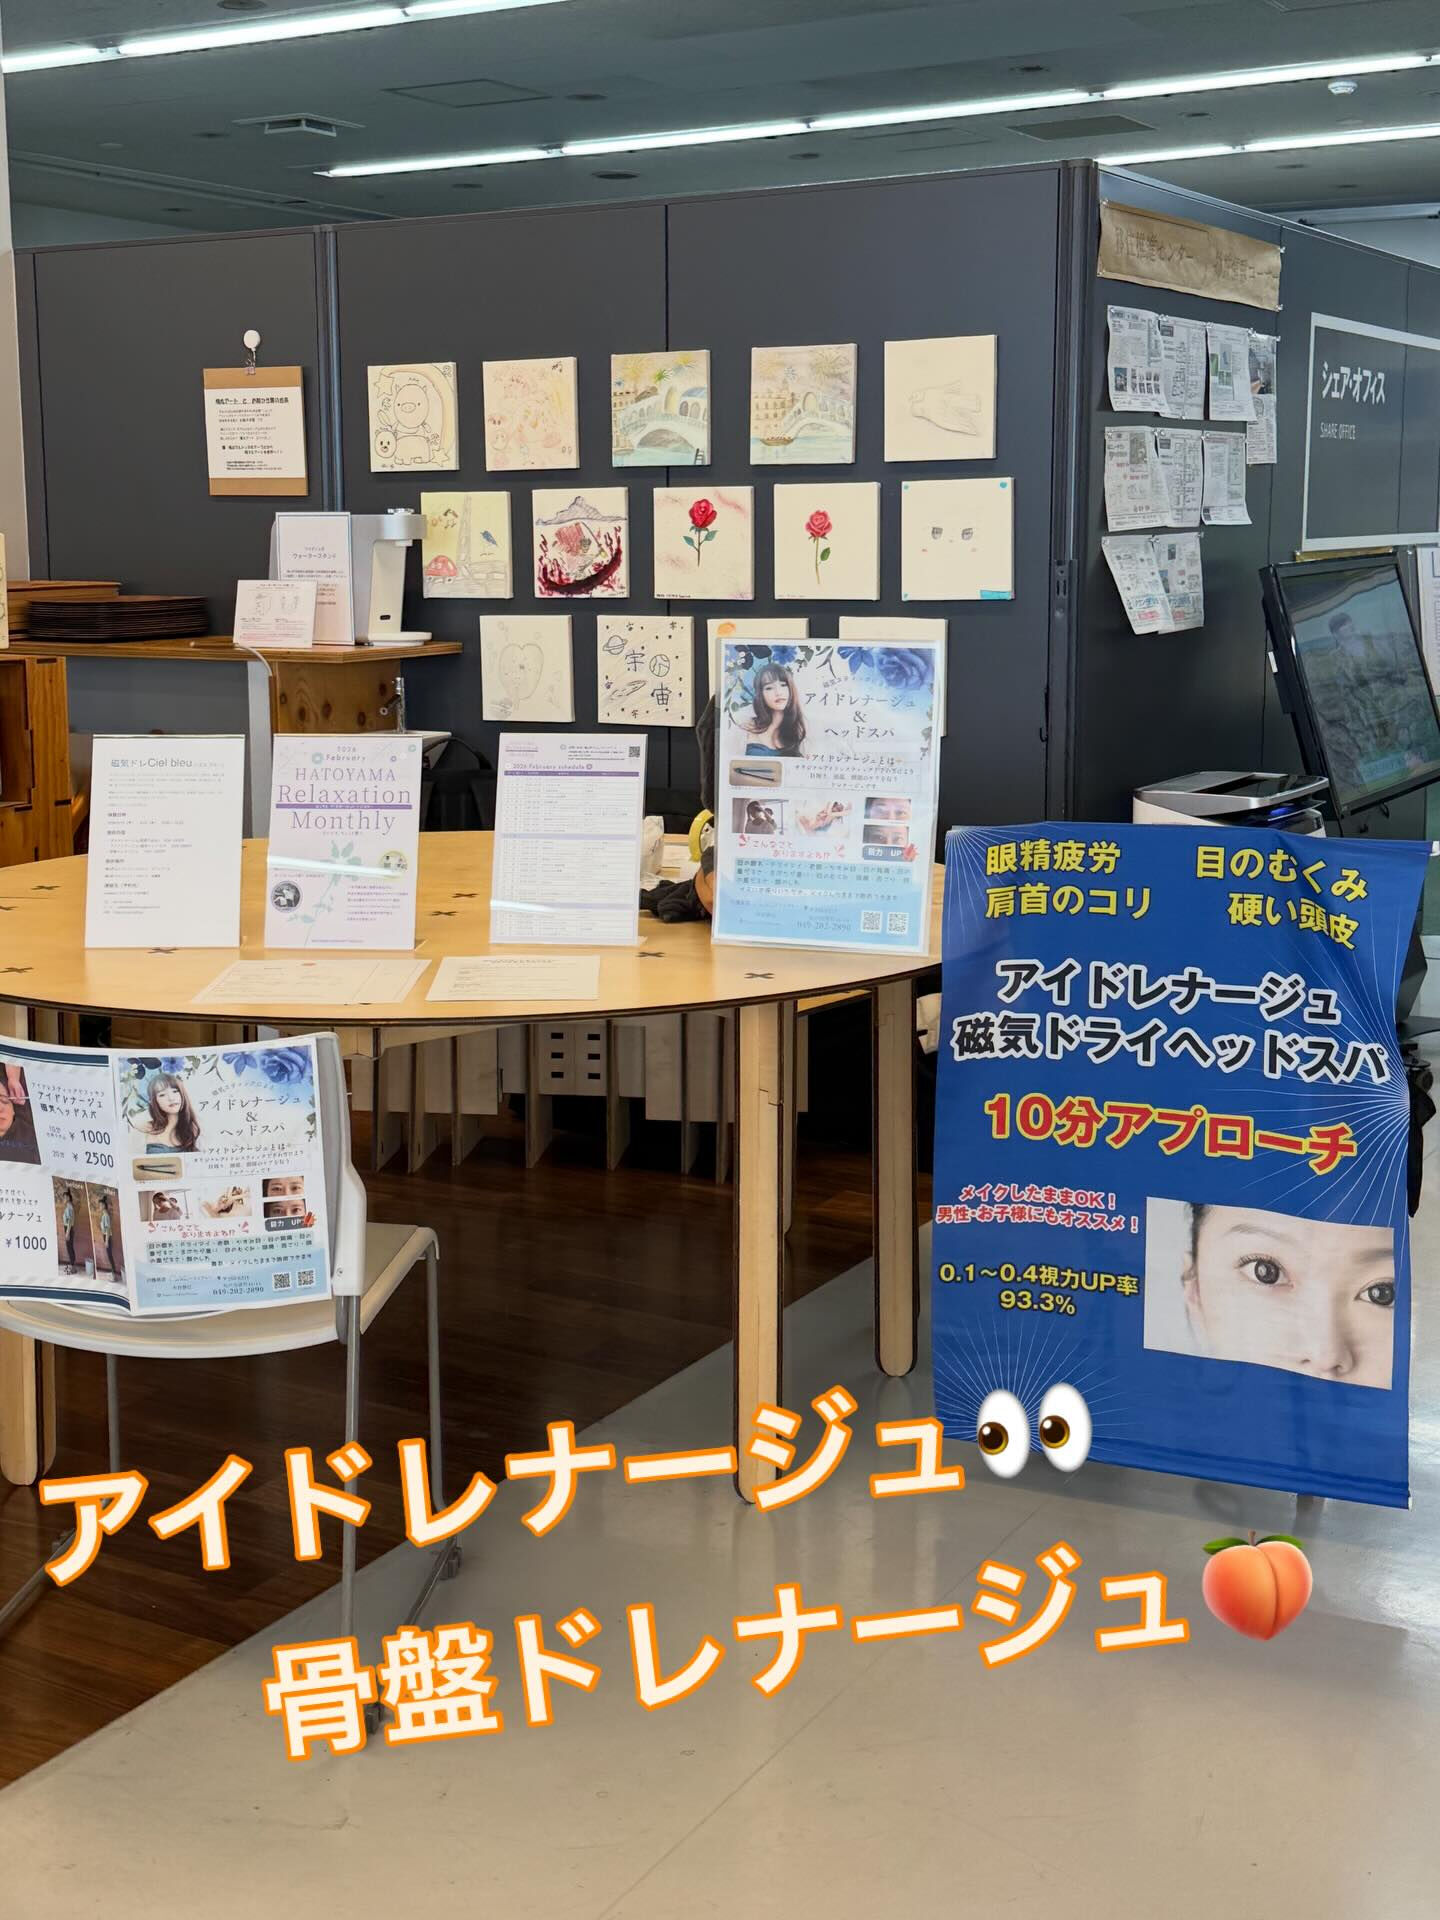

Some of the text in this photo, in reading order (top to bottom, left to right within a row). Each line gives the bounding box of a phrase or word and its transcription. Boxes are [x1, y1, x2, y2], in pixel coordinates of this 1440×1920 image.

[1322, 361, 1386, 404] シェア・オフィス
[1320, 421, 1356, 440] SHARE OFFICE
[804, 691, 917, 709] アイドレナージュ
[853, 711, 867, 723] &
[824, 726, 895, 739] ヘッドスパ
[170, 758, 193, 768] bleu
[326, 753, 367, 762] February
[295, 767, 396, 781] HATOYAMA
[278, 784, 411, 803] Relaxation
[292, 811, 396, 836] Monthly
[890, 850, 902, 858] UP
[986, 841, 1121, 875] 眼精疲労
[1195, 845, 1369, 903] 目のむくみ
[985, 883, 1151, 920] 肩首のコリ
[1227, 892, 1359, 950] 硬い頭皮
[997, 960, 1340, 1023] アイドレナージュ
[953, 1012, 1391, 1084] 磁気ドライヘッドスパ
[38, 1091, 102, 1109] アイドレナージュ
[199, 1093, 300, 1112] アイドレナージュ
[246, 1112, 258, 1122] &
[81, 1130, 111, 1145] 1000
[220, 1123, 285, 1136] ヘッドスパ
[985, 1093, 1358, 1174] 10分アプローチ
[85, 1151, 114, 1168] 2500
[1000, 1290, 1076, 1316] 93.3%
